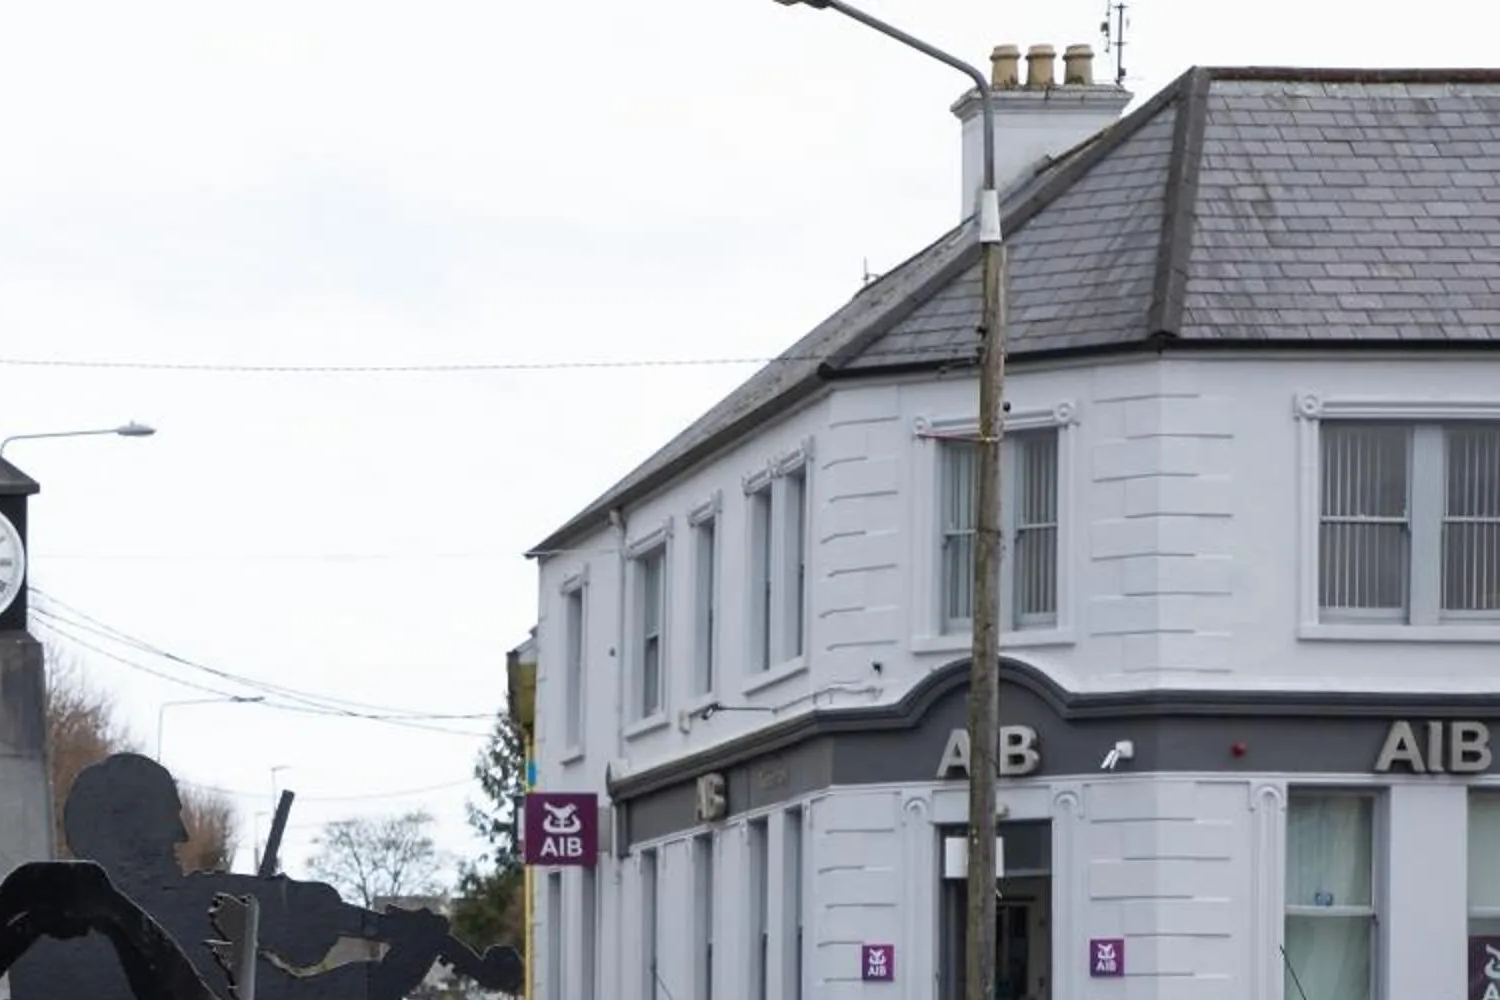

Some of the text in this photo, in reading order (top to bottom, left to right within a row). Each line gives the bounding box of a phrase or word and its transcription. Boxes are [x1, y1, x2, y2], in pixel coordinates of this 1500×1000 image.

[937, 725, 1040, 778] AB
[1374, 721, 1491, 775] AIB
[540, 836, 583, 858] AIB
[868, 965, 887, 977] AIB
[1095, 960, 1117, 973] AIB
